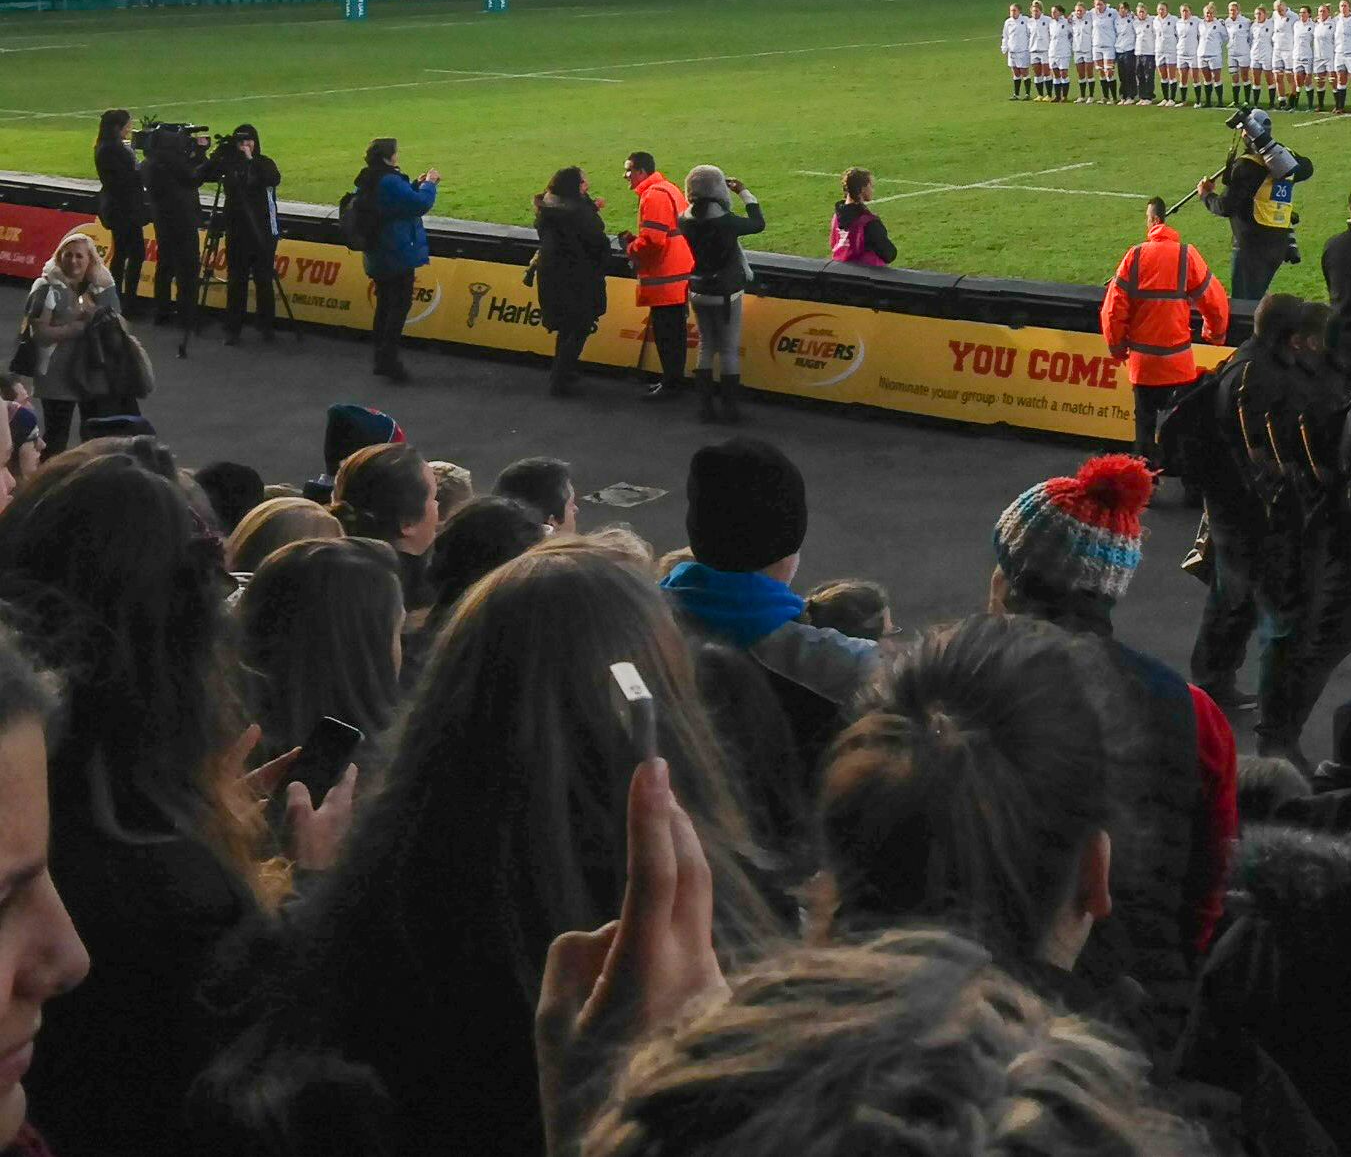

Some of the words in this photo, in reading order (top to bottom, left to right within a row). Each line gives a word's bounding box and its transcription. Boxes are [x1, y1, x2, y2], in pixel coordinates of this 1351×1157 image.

[1275, 184, 1287, 198] 26
[296, 257, 341, 286] YOU
[777, 336, 856, 360] DELIVERS
[949, 340, 1017, 378] YOU
[1028, 349, 1123, 389] COME
[1017, 394, 1048, 411] watch
[1050, 400, 1058, 411] a
[1062, 398, 1094, 417] match
[1097, 404, 1108, 417] at
[1111, 405, 1130, 421] The
